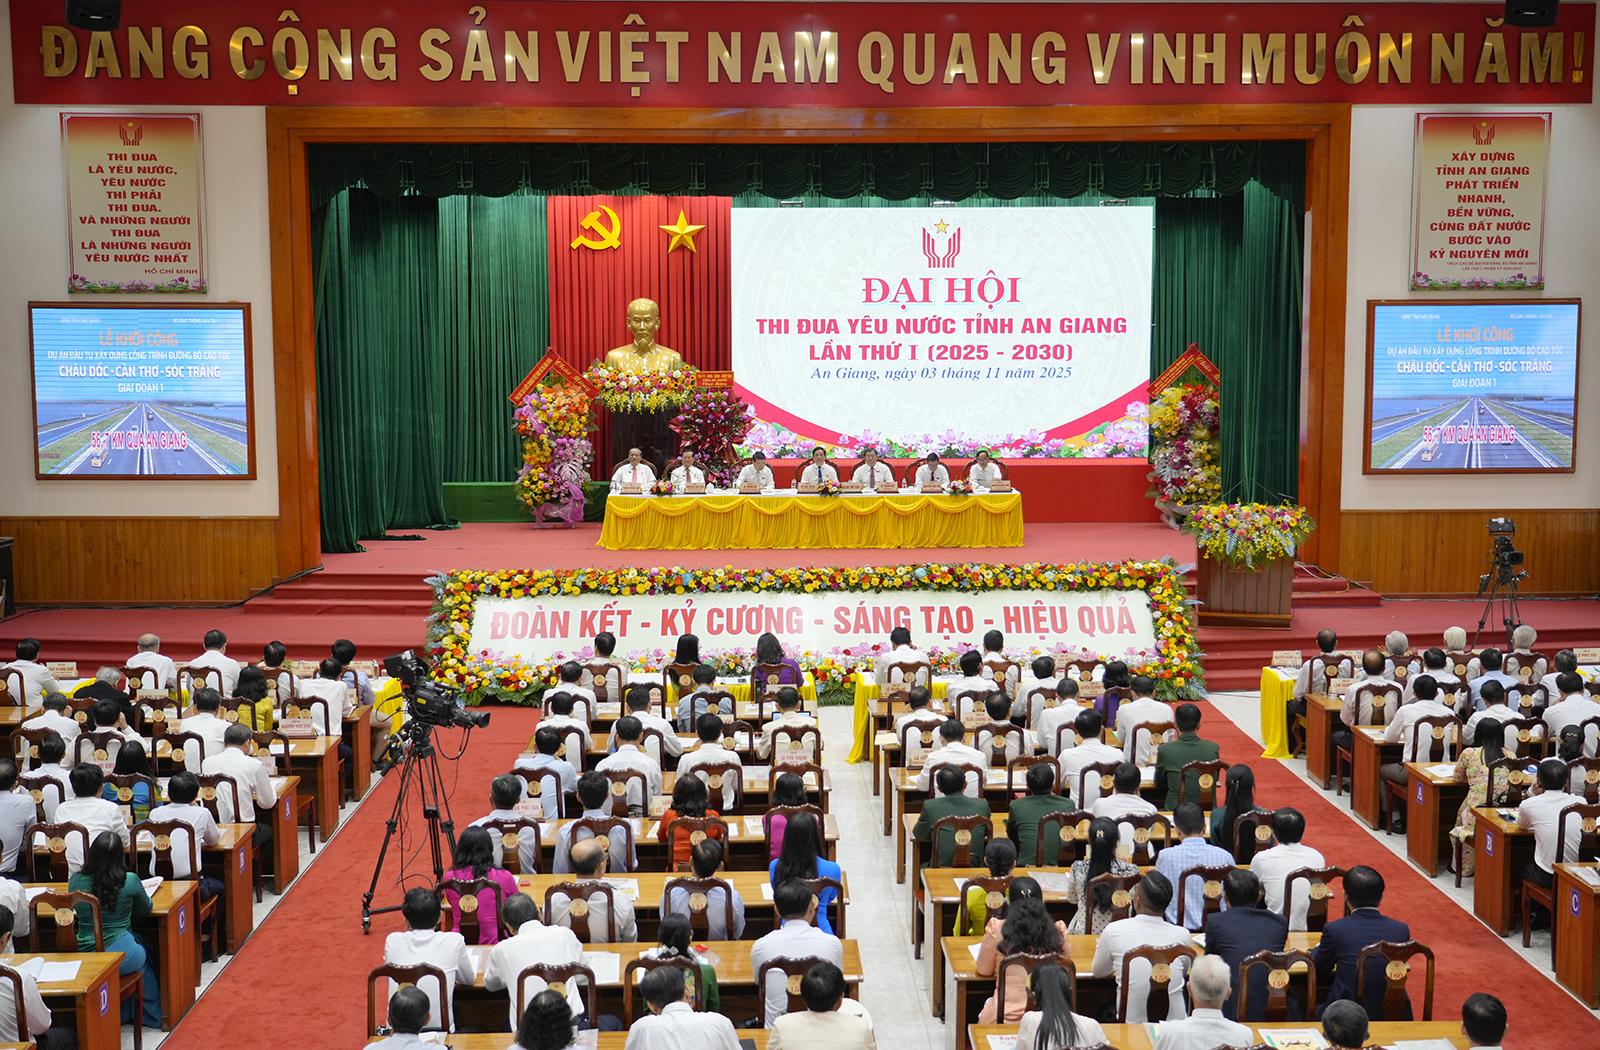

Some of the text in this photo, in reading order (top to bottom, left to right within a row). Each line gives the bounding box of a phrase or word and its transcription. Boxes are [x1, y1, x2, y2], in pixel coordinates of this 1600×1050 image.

[229, 10, 397, 95] CỘNG
[419, 5, 539, 83] SẢN
[555, 14, 689, 97] VIỆT
[707, 31, 839, 84] NAM
[857, 31, 1067, 93] QUANG
[1086, 32, 1227, 85] VINH
[1241, 15, 1412, 85] MUÔN
[107, 153, 158, 162] THI ĐUA
[1452, 151, 1515, 163] XÂY DỰNG
[88, 164, 104, 174] LÀ
[108, 164, 133, 174] YÊU
[1436, 164, 1530, 176] TỈNH AN GIANG
[101, 177, 166, 187] YÊU NƯỚC
[1446, 177, 1519, 190] PHÁT TRIỂN
[107, 204, 128, 212] THI
[79, 215, 96, 225] VÀ
[150, 215, 191, 225] NGƯỜI
[1430, 219, 1531, 231] CÙNG ĐẤT NƯỚC
[110, 229, 161, 237] THI ĐUA
[81, 240, 97, 250] LÀ
[151, 240, 192, 250] NGƯỜI
[1448, 234, 1511, 245] BƯỚC VÀO
[85, 252, 189, 263] YÊU NƯỚC NHẤT
[1450, 248, 1500, 259] NGUYÊN
[1504, 248, 1529, 259] MỚI
[861, 270, 1021, 310] ĐẠI HỘI
[756, 313, 1127, 334] THI ĐUA YÊU NƯỚC TỈNH AN GIANG
[809, 339, 851, 360] LẦN
[858, 341, 902, 360] THỨ
[908, 345, 919, 360] I
[928, 344, 989, 362] (2025
[1012, 344, 1073, 362] 2030)
[59, 363, 87, 378] CHÂU
[89, 362, 110, 378] ĐỐC
[115, 361, 136, 378] CẦN
[139, 365, 160, 378] THƠ
[165, 363, 185, 378] SÓC
[1397, 360, 1423, 373] CHÂU
[1425, 359, 1446, 373] ĐỐC
[1451, 359, 1471, 373] CẦN
[1473, 361, 1493, 373] THƠ
[1499, 360, 1518, 373] SÓC
[811, 367, 1072, 381] An Giang, ngày 03 tháng 11 năm 2025
[117, 383, 134, 393] GIAI
[1452, 379, 1468, 388] GIAI
[112, 432, 125, 449] KM
[146, 432, 158, 449] AN
[160, 432, 187, 449] GIANG
[1442, 426, 1457, 443] KM
[1476, 426, 1487, 443] AN
[1488, 426, 1515, 443] GIANG
[490, 604, 570, 640] ĐOÀN
[579, 601, 632, 638] KẾT
[660, 599, 697, 636] KỶ
[706, 604, 804, 636] CƯƠNG
[833, 600, 911, 635] SÁNG
[919, 605, 974, 640] TẠO
[1003, 600, 1068, 640] HIỆU
[1077, 596, 1137, 635] QUẢ
